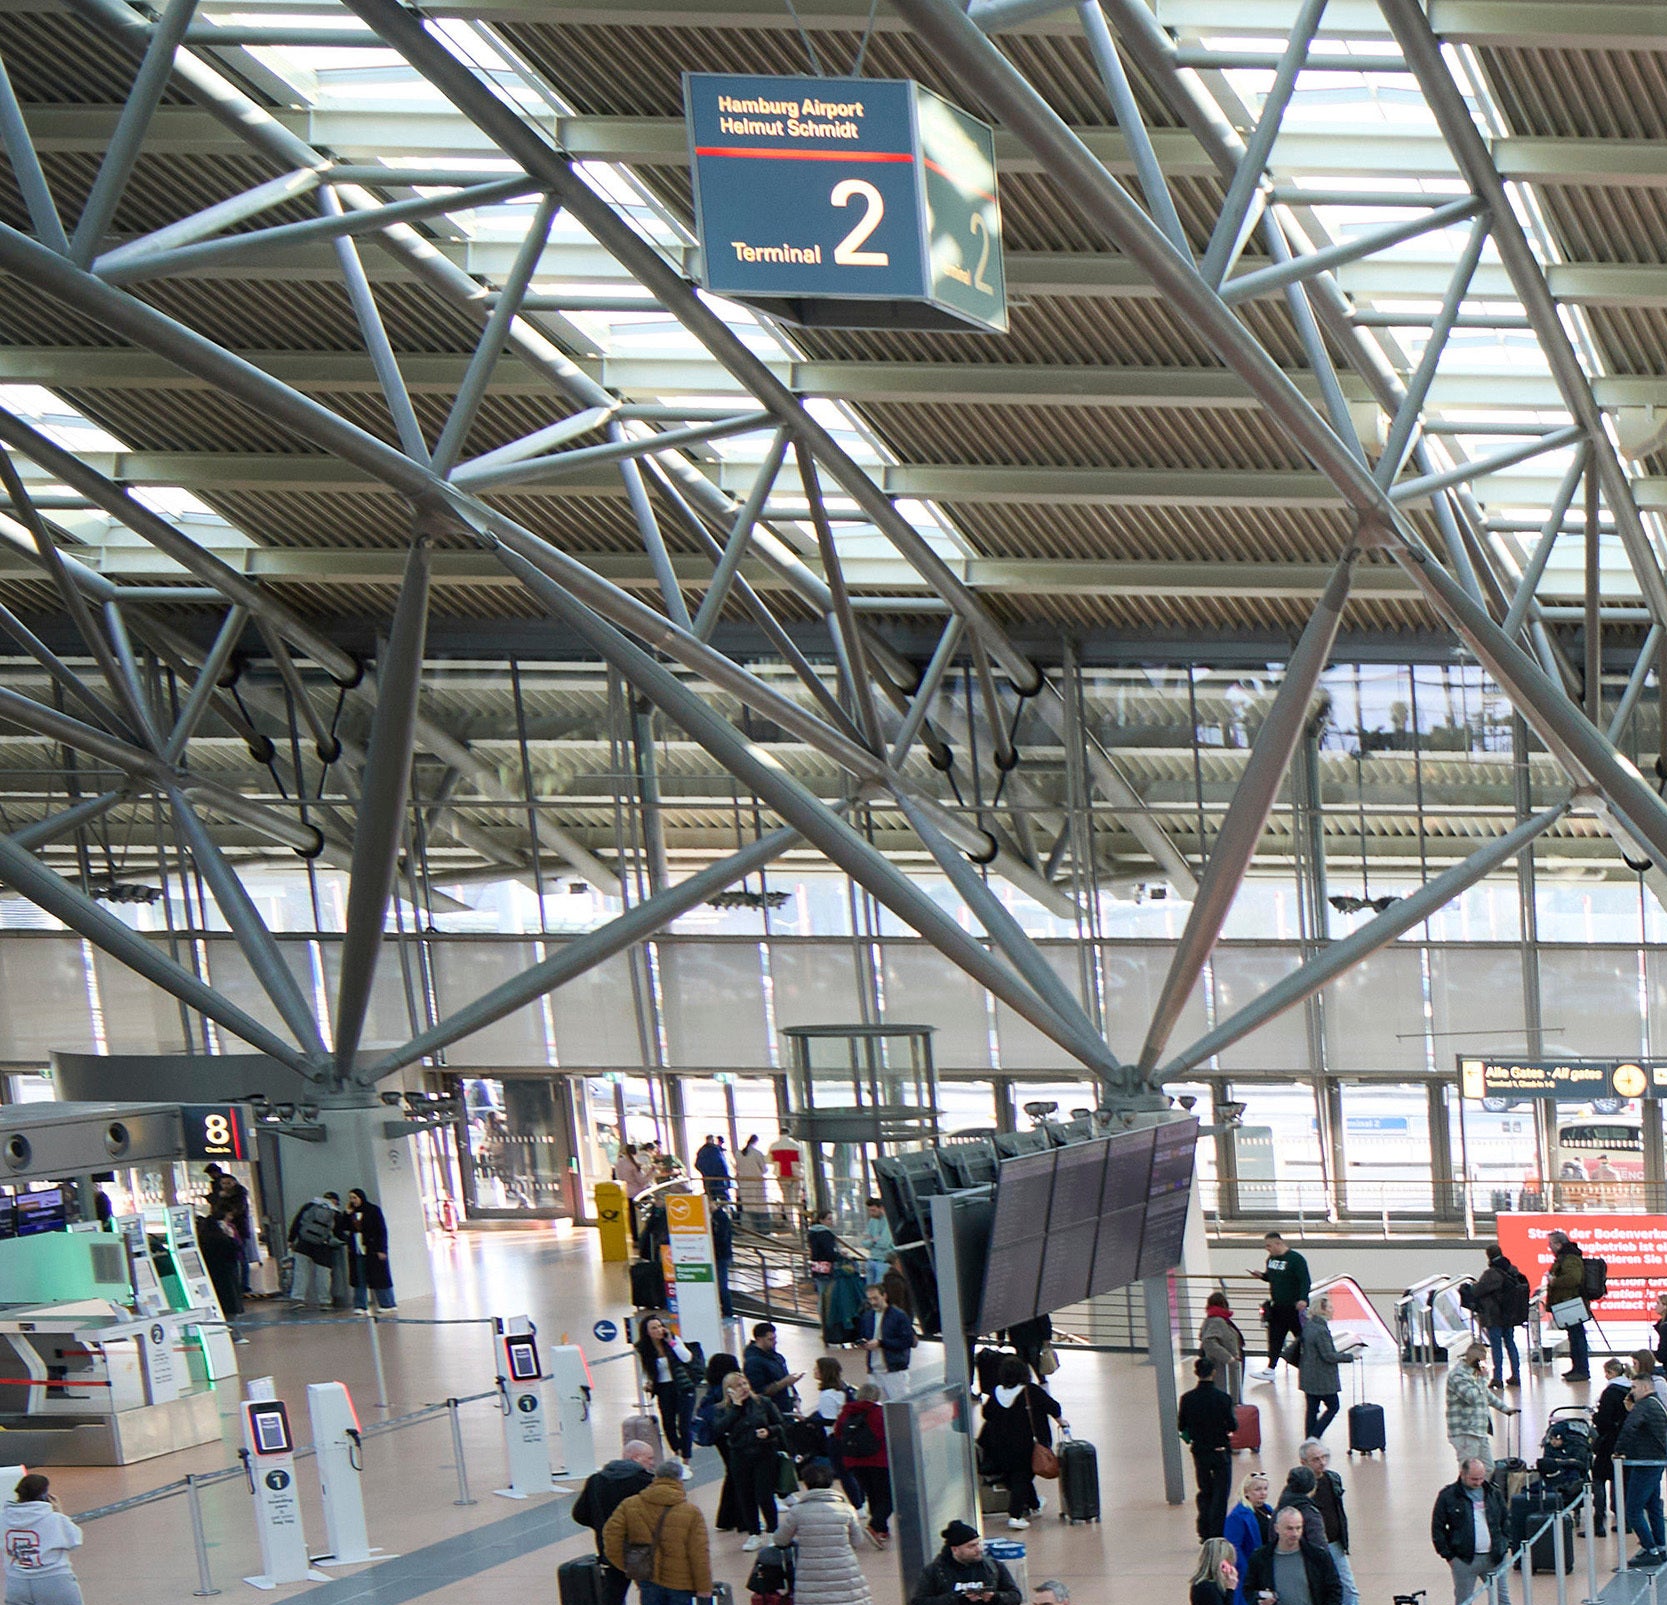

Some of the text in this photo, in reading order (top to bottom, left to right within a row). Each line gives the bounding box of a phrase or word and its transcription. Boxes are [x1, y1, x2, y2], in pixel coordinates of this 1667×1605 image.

[718, 95, 864, 120] Hamburg Airport
[720, 117, 859, 139] Helmut Schmidt
[731, 179, 889, 266] Terminal 2
[970, 212, 994, 295] 2
[1485, 1066, 1603, 1082] Alle Gates All gates
[204, 1113, 231, 1145] 8
[1569, 1228, 1592, 1239] der
[1639, 1242, 1654, 1252] ist
[1643, 1254, 1662, 1264] Sie
[1600, 1300, 1644, 1310] contact
[272, 1476, 282, 1488] 1
